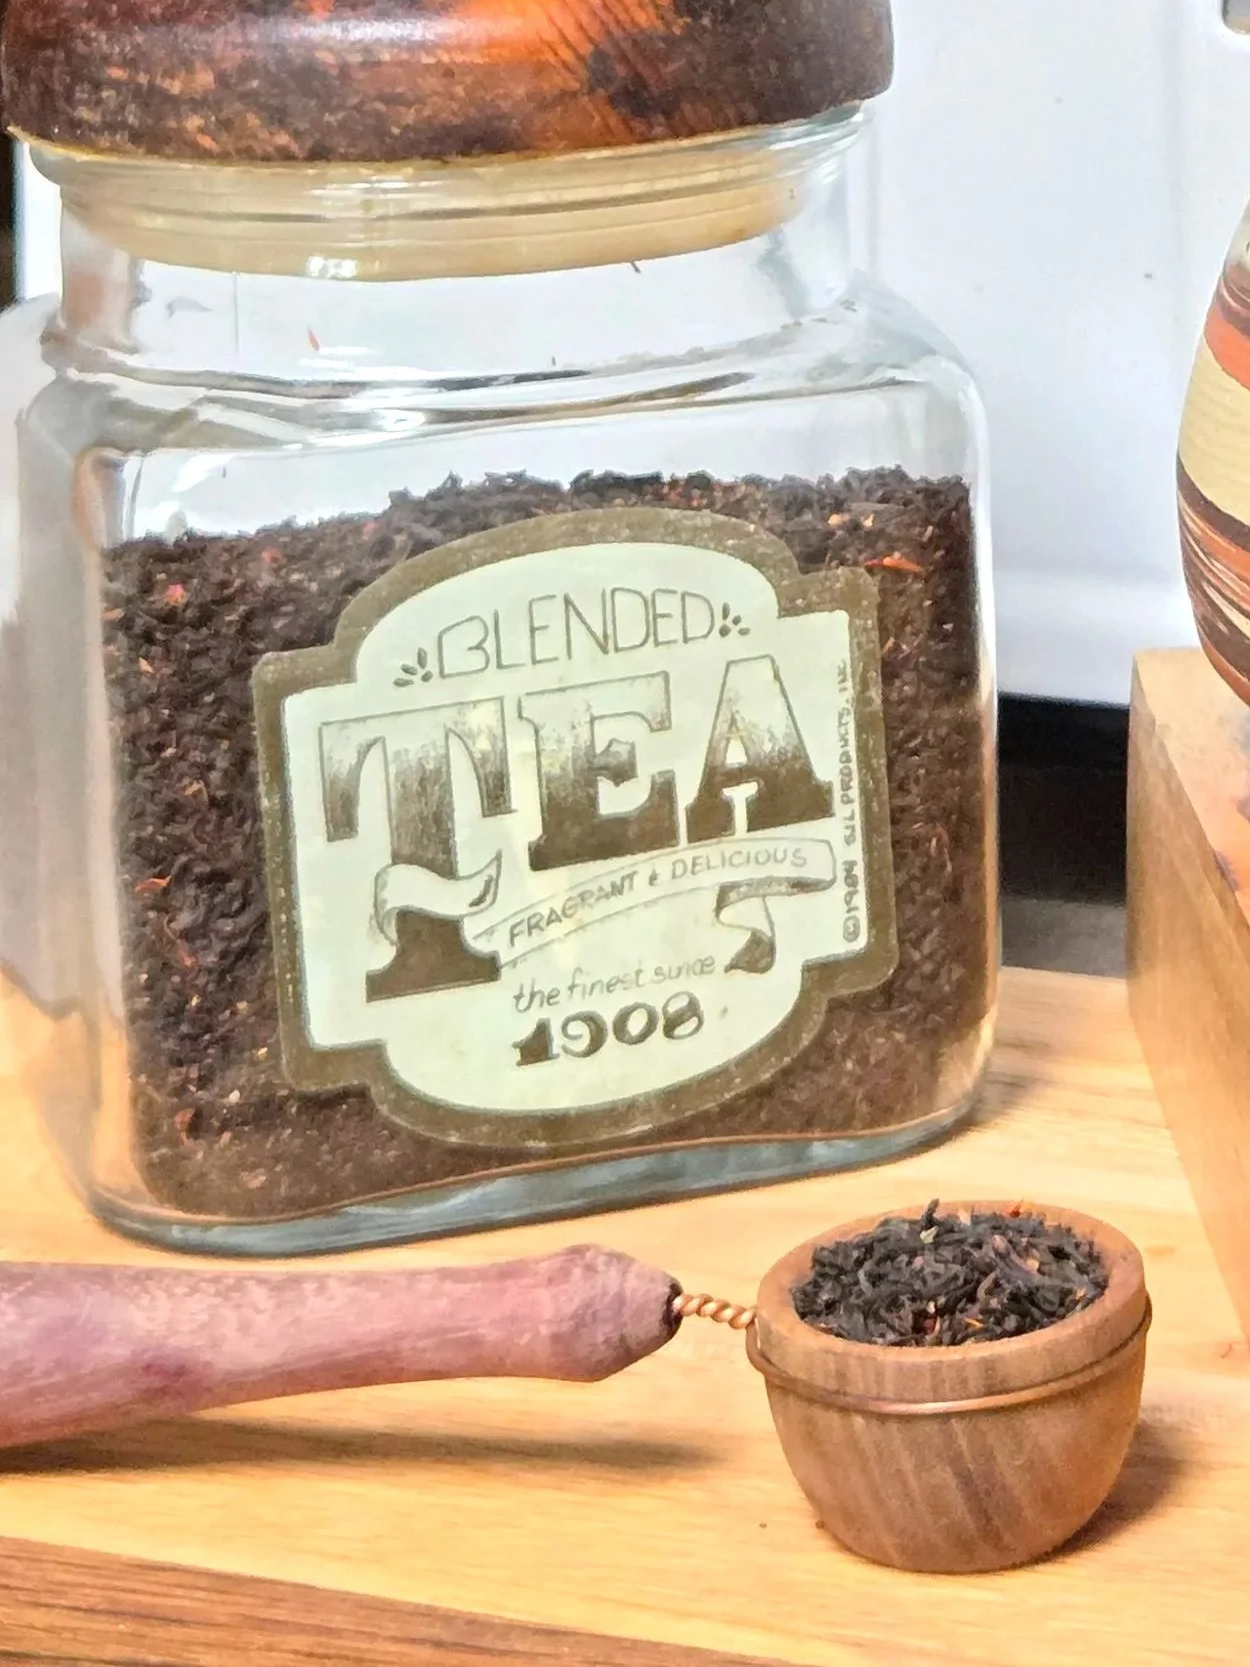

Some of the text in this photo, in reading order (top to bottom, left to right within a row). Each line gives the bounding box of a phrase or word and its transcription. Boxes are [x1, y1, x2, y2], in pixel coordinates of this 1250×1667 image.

[437, 587, 716, 679] BLENDED
[318, 653, 836, 1003] TEA
[508, 870, 639, 948] FRAGRANT
[671, 846, 809, 881] DELICIOUS
[511, 978, 562, 1013] the
[567, 962, 647, 1000] finest
[511, 990, 705, 1067] 1908
